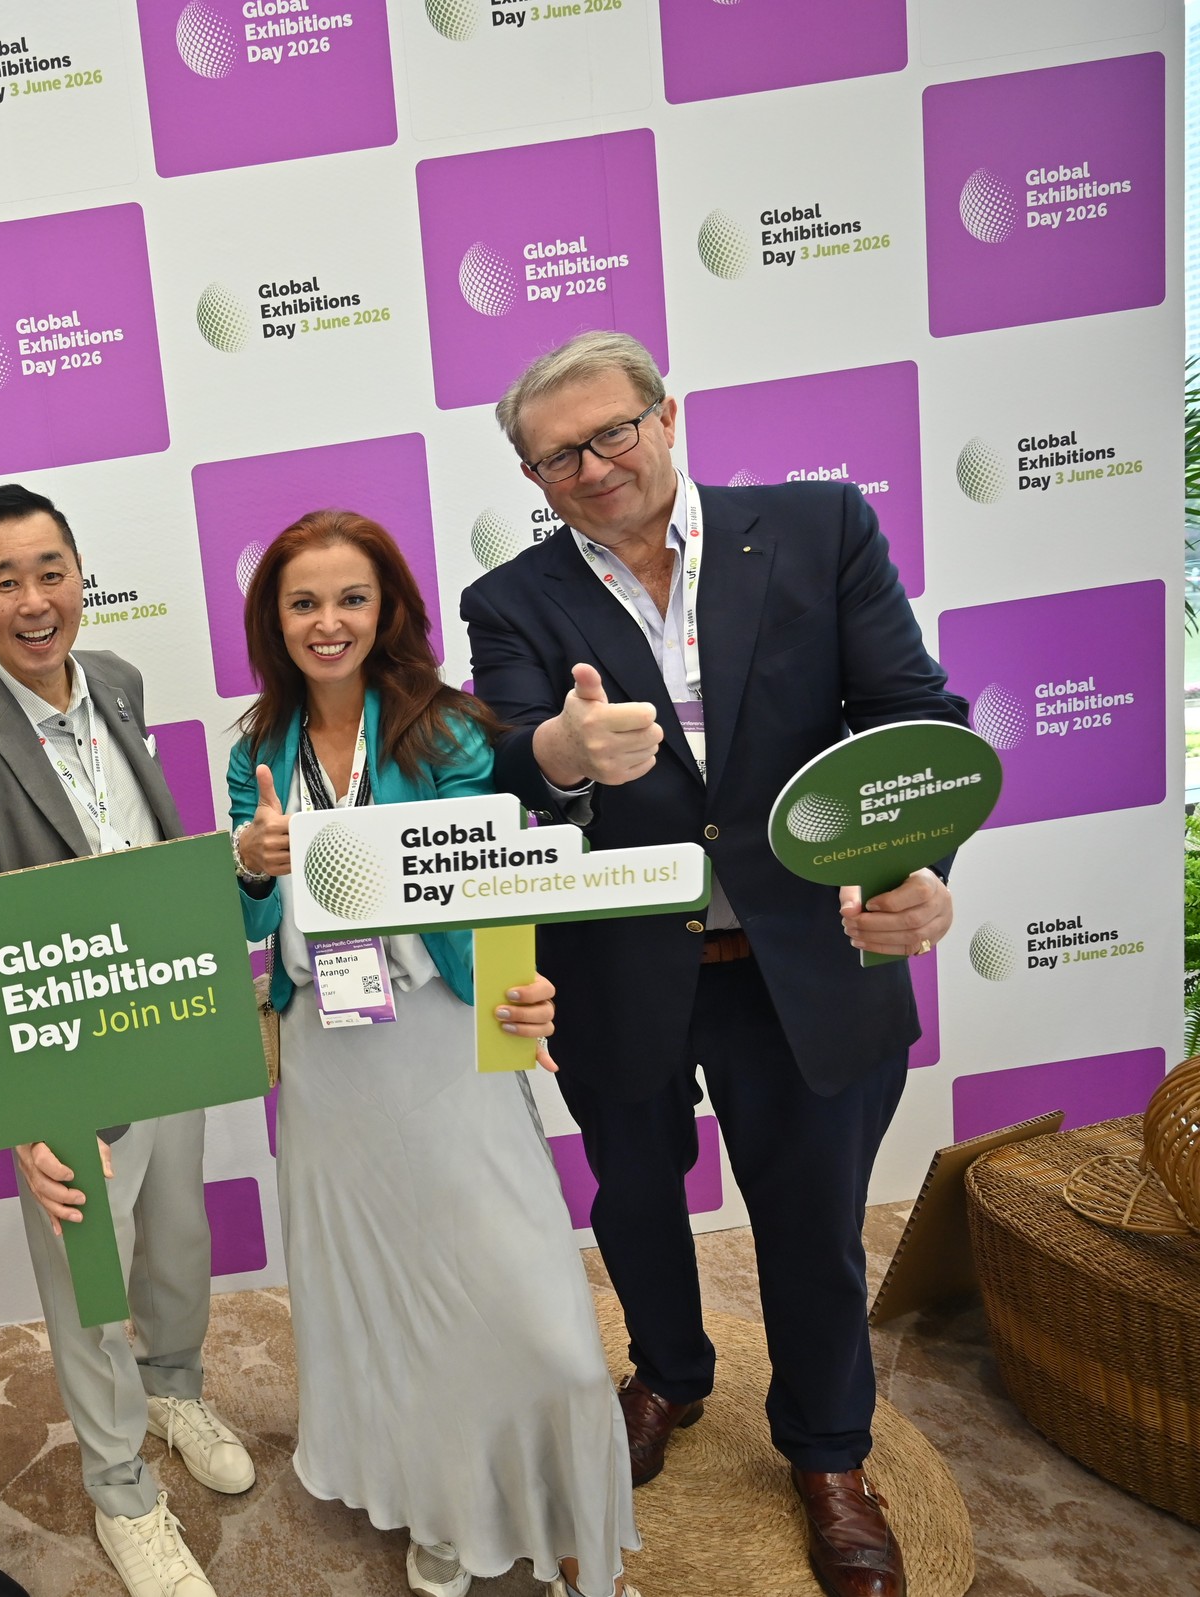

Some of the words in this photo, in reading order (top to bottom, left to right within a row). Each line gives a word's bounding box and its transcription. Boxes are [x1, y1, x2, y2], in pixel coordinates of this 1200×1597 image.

[243, 0, 309, 18] Global
[492, 11, 525, 27] Day
[531, 7, 539, 20] 3
[544, 4, 581, 19] June
[584, 0, 622, 14] 2026
[245, 14, 352, 40] Exhibitions
[247, 46, 283, 63] Day
[288, 37, 330, 56] 2026
[10, 83, 19, 96] 3
[23, 79, 61, 94] June
[64, 70, 102, 88] 2026
[1026, 162, 1090, 185] Global
[1027, 181, 1131, 207] Exhibitions
[760, 204, 821, 225] Global
[1027, 212, 1062, 227] Day
[1066, 203, 1107, 222] 2026
[762, 221, 861, 245] Exhibitions
[524, 236, 587, 259] Global
[763, 250, 795, 265] Day
[801, 247, 809, 259] 3
[813, 244, 850, 258] June
[854, 235, 890, 252] 2026
[526, 255, 628, 280] Exhibitions
[259, 277, 320, 298] Global
[527, 285, 561, 301] Day
[566, 277, 606, 295] 2026
[261, 294, 360, 318] Exhibitions
[16, 310, 80, 334] Global
[263, 324, 295, 339] Day
[300, 320, 309, 332] 3
[313, 316, 350, 330] June
[354, 308, 390, 325] 2026
[19, 329, 123, 355] Exhibitions
[22, 360, 56, 375] Day
[60, 351, 102, 369] 2026
[1018, 431, 1077, 452] Global
[1019, 448, 1115, 471] Exhibitions
[1019, 476, 1050, 490] Day
[1056, 472, 1064, 484] 3
[1068, 469, 1103, 482] June
[1107, 460, 1142, 477] 2026
[81, 615, 88, 626] 3
[93, 612, 128, 625] June
[132, 603, 167, 620] 2026
[1035, 677, 1095, 698] Global
[1036, 693, 1134, 717] Exhibitions
[1036, 721, 1069, 736] Day
[1073, 713, 1111, 730] 2026
[860, 768, 934, 796] Global
[861, 774, 981, 811] Exhibitions
[861, 808, 900, 825] Day
[401, 821, 496, 848] Global
[813, 842, 888, 865] Celebrate
[892, 831, 926, 846] with
[931, 824, 954, 837] us!
[403, 848, 558, 876] Exhibitions
[404, 883, 454, 906] Day
[462, 872, 576, 898] Celebrate
[583, 864, 636, 888] with
[643, 861, 678, 882] us!
[1027, 916, 1082, 935] Global
[1028, 930, 1118, 952] Exhibitions
[336, 955, 358, 964] Maria
[1028, 956, 1058, 969] Day
[1062, 952, 1070, 963] 3
[1073, 949, 1107, 962] June
[1111, 942, 1144, 956] 2026
[2, 953, 217, 1015] Exhibitions
[320, 969, 350, 977] Arango
[10, 1018, 80, 1053] Day
[92, 1001, 160, 1036] Join
[170, 987, 216, 1020] us!
